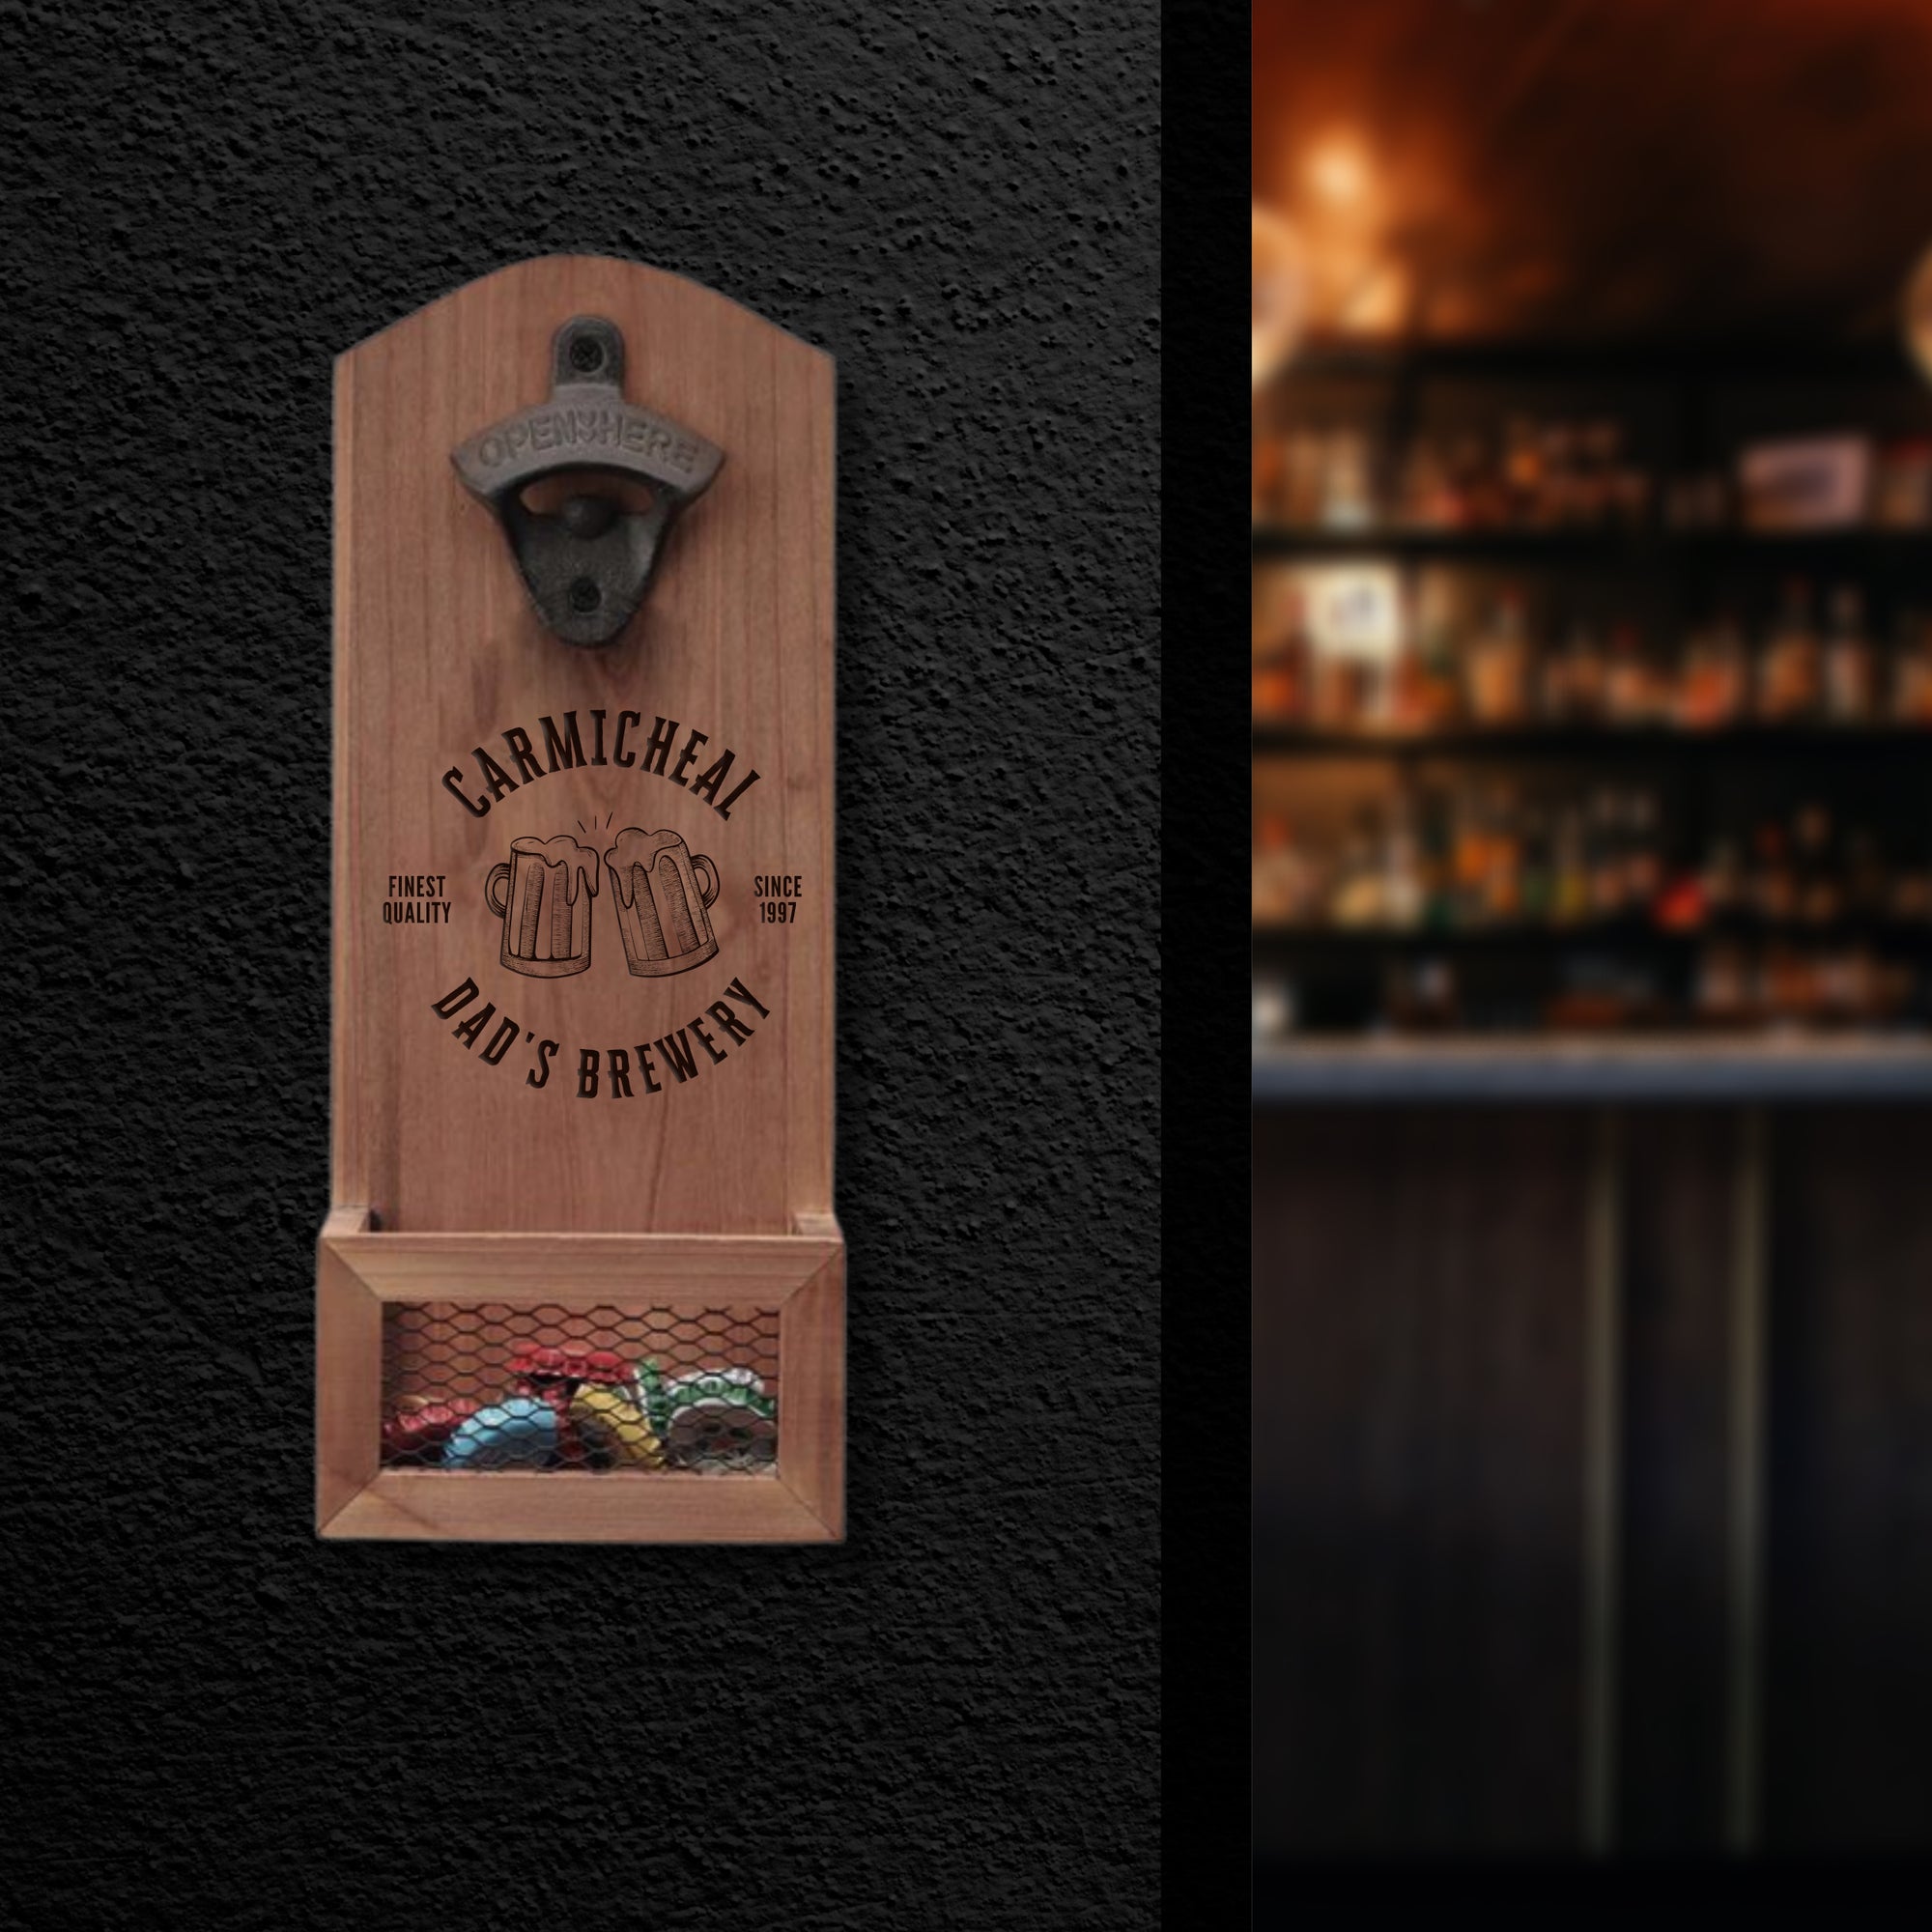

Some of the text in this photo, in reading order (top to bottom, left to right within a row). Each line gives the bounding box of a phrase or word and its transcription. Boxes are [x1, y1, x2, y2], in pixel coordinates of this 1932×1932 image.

[479, 410, 698, 474] OPEN HERE
[440, 709, 761, 821] CARMICHEAL
[388, 875, 446, 898] FINEST
[753, 875, 803, 898] SINCE
[383, 901, 452, 925] QUALITY
[759, 901, 797, 924] 1997
[431, 977, 771, 1099] DAD'S BREWERY
